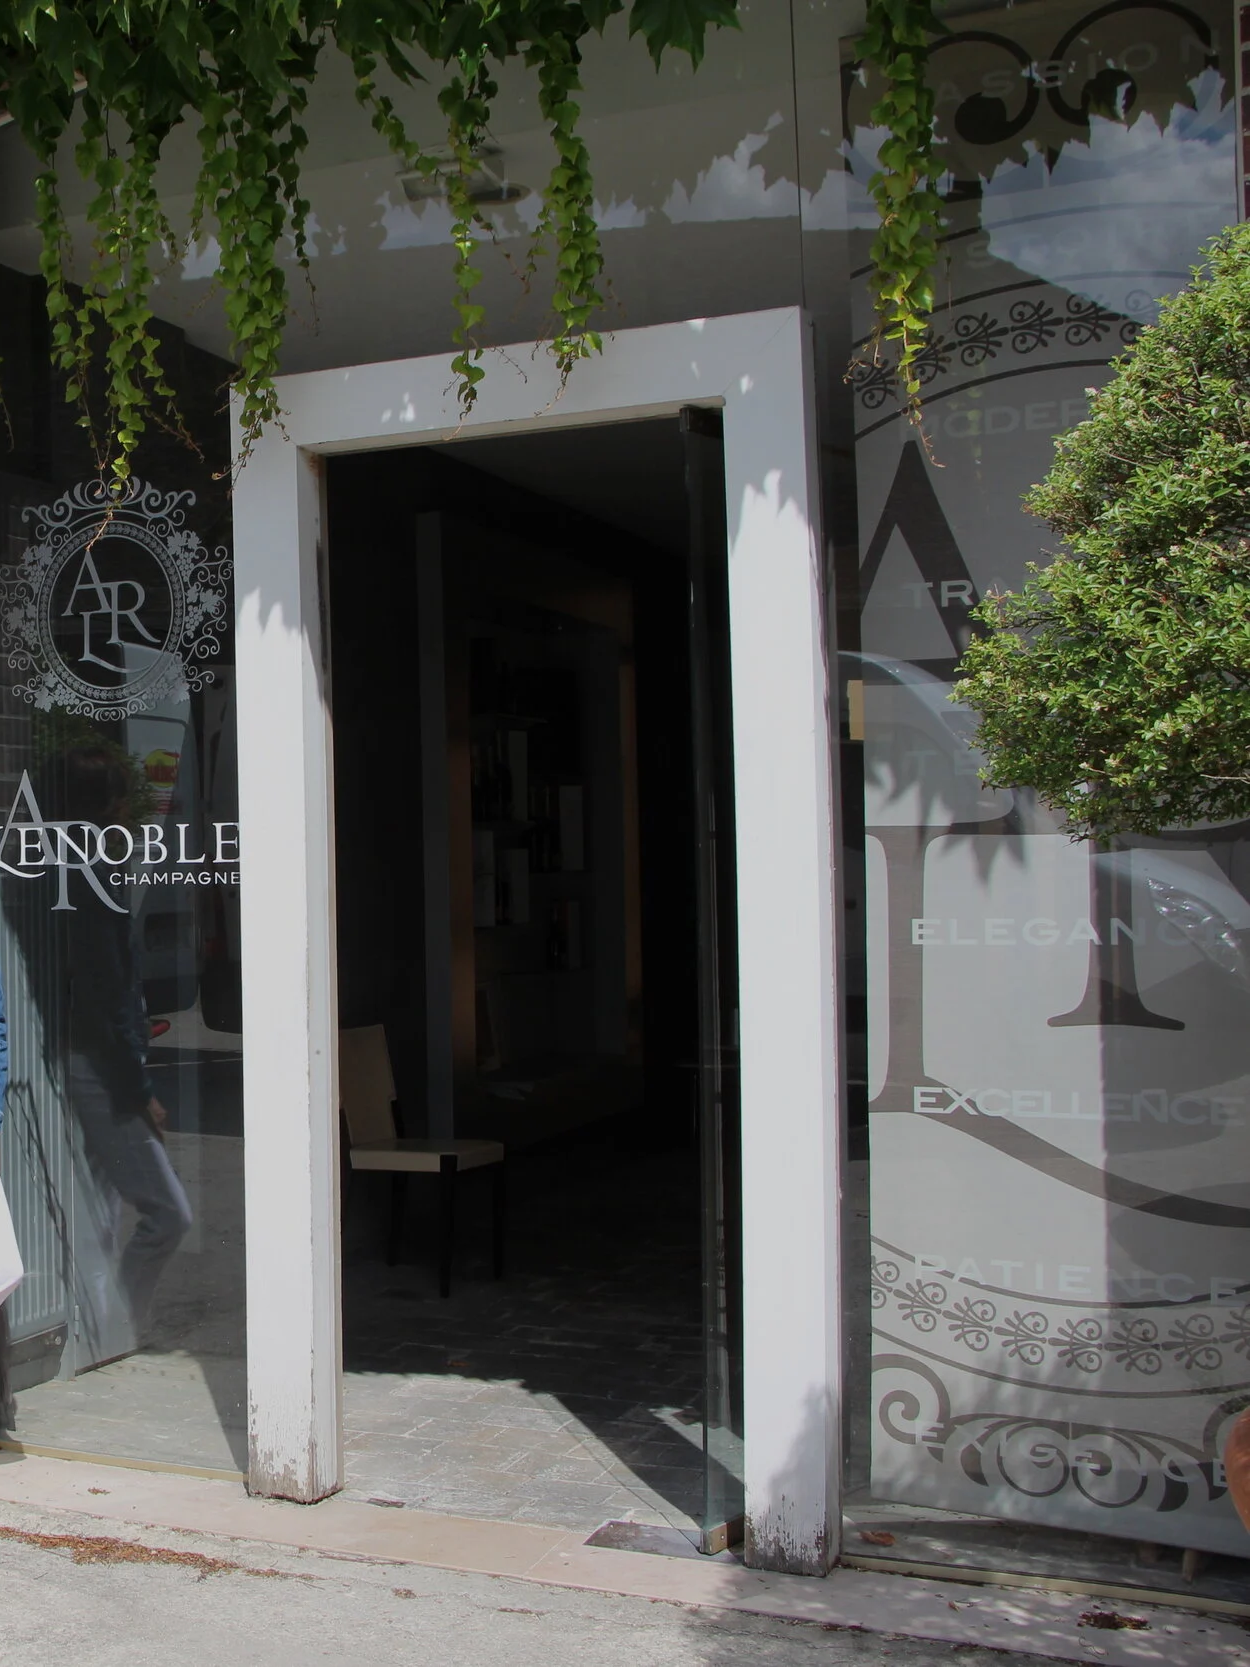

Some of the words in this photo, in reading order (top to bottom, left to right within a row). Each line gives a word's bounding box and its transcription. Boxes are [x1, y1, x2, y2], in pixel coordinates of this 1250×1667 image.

[935, 25, 1222, 104] ASSION
[109, 871, 241, 886] CHAMPAGNE
[913, 1086, 1246, 1128] EXCELLENCE
[914, 1252, 1246, 1307] PATIENCE
